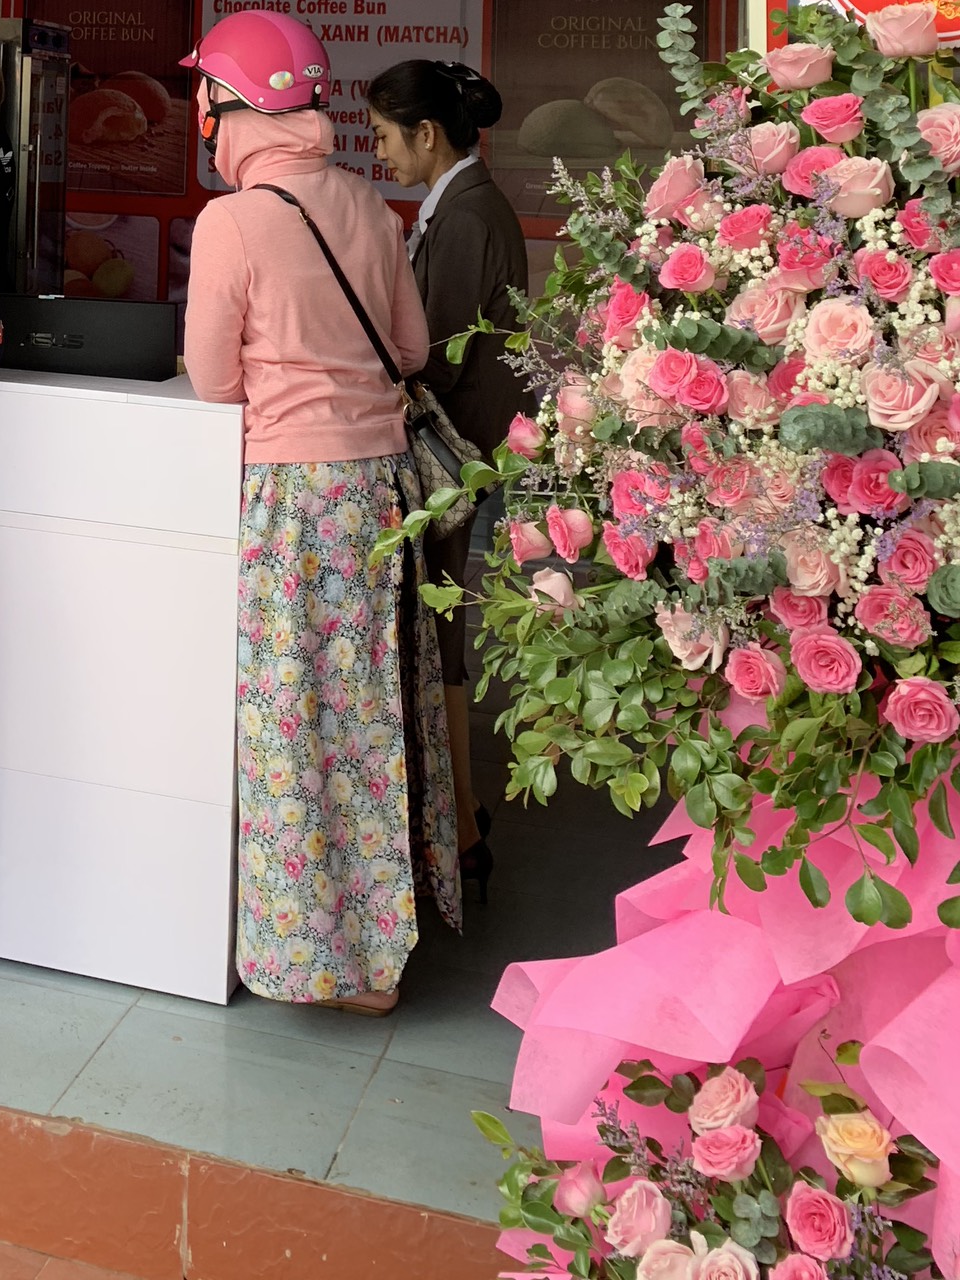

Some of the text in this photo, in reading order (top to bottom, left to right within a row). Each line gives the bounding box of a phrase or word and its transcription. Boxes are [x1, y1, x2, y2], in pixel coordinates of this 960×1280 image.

[68, 11, 146, 25] ORIGINAL
[551, 16, 649, 32] ORIGINAL
[70, 27, 155, 41] OFFEE BUN
[320, 25, 369, 43] XANH
[377, 25, 469, 48] (MATCHA)
[538, 33, 612, 49] COFFEE
